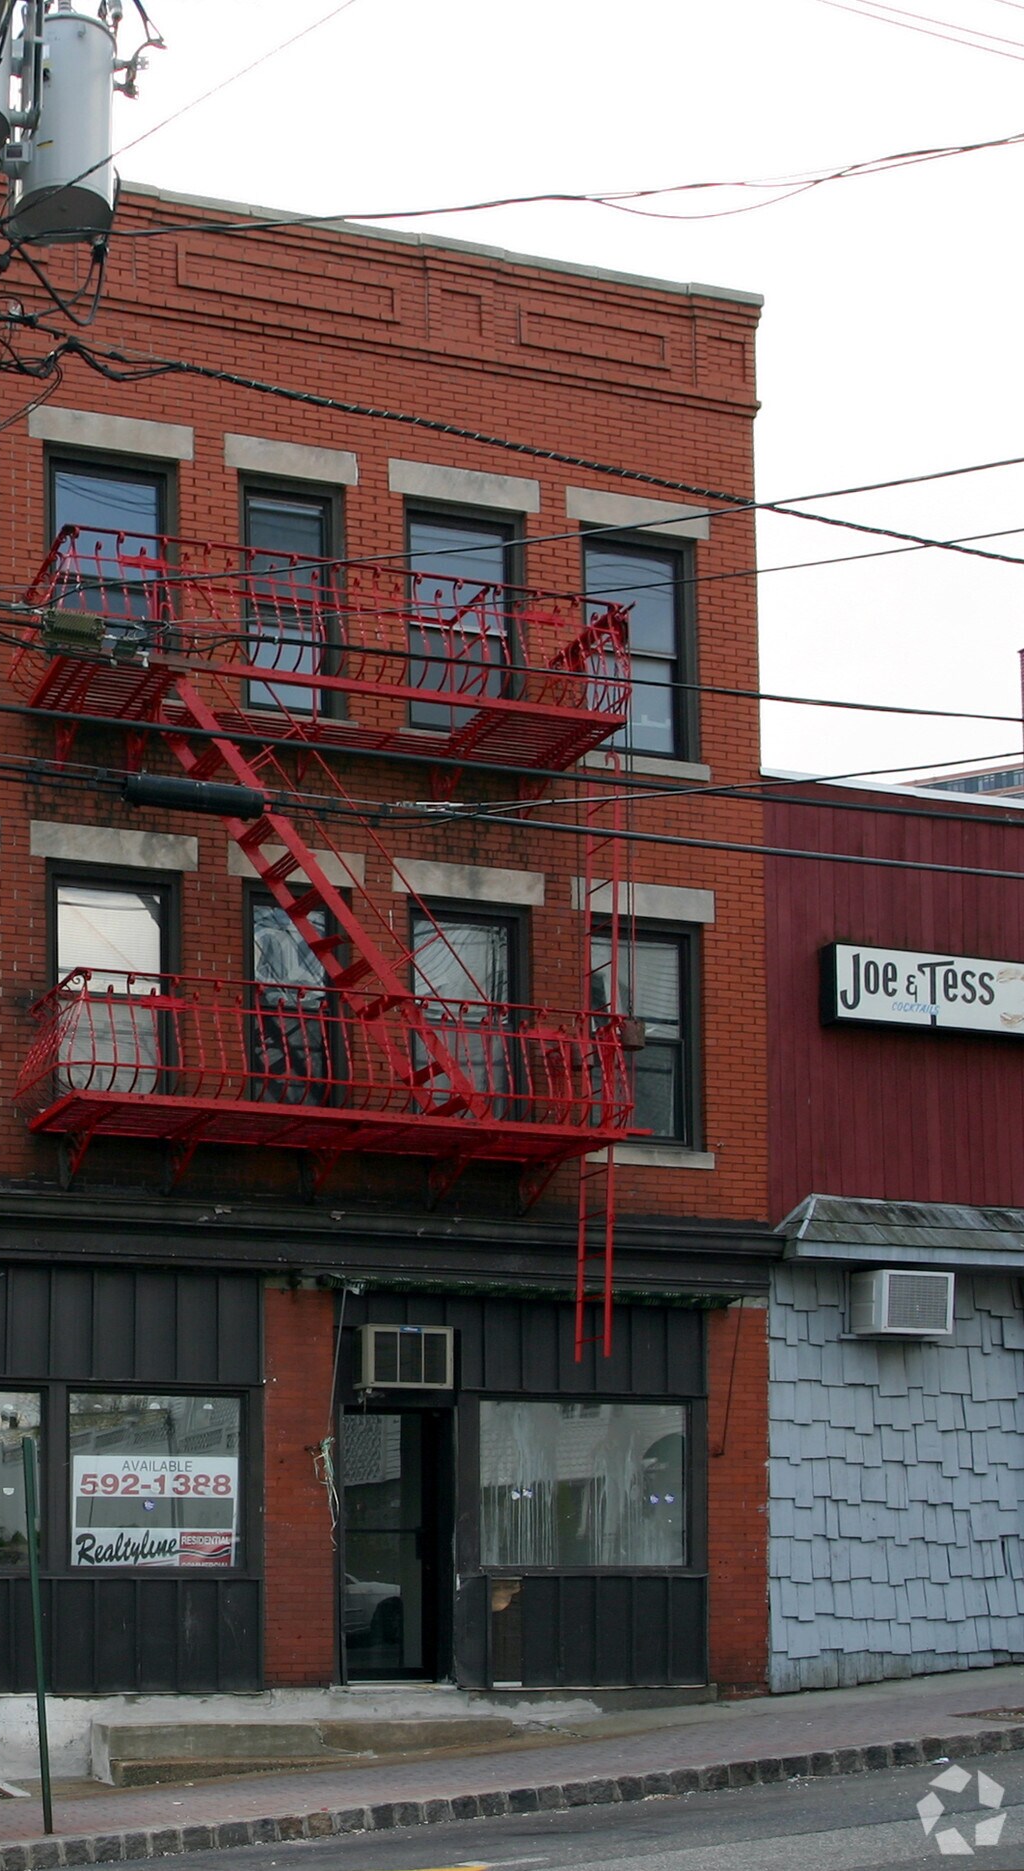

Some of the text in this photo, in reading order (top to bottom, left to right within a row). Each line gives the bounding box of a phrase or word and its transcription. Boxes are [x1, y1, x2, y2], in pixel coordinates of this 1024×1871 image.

[839, 953, 995, 1026] Joe & Tess
[891, 1001, 940, 1015] COCKTAILS
[122, 1460, 193, 1473] AVAILABLE
[79, 1473, 232, 1496] 592-1388
[75, 1529, 177, 1566] Realtyline
[181, 1535, 231, 1545] RESIDENTIAL
